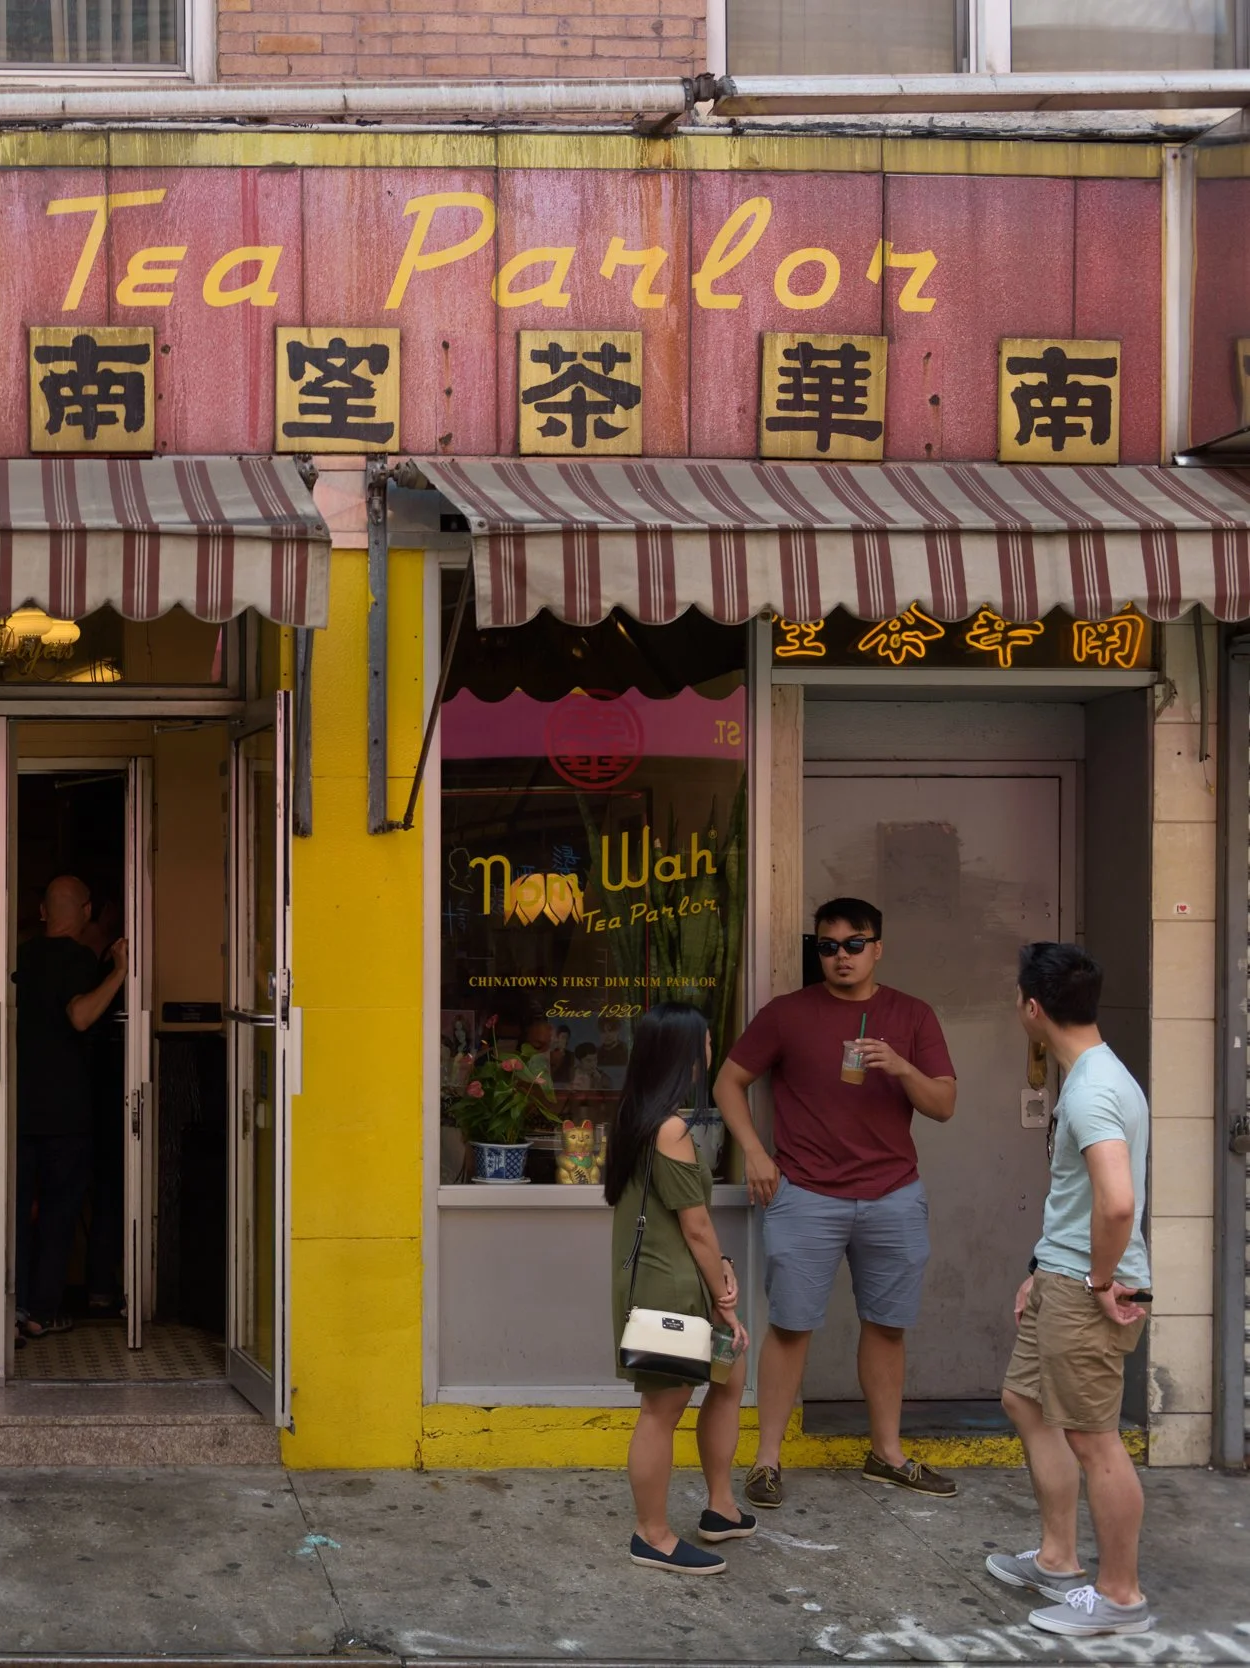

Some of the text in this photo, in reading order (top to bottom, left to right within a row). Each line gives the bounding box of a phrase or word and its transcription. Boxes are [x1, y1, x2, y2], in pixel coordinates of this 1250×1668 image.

[46, 188, 284, 311] Tea
[384, 191, 939, 312] Parlor
[469, 855, 584, 916] Nom
[602, 825, 717, 891] Wah
[583, 896, 718, 933] Tea Parlor
[469, 976, 717, 988] CHINATOWN'S FIRST DIM SUM PARLOR
[545, 999, 643, 1018] Since 1920
